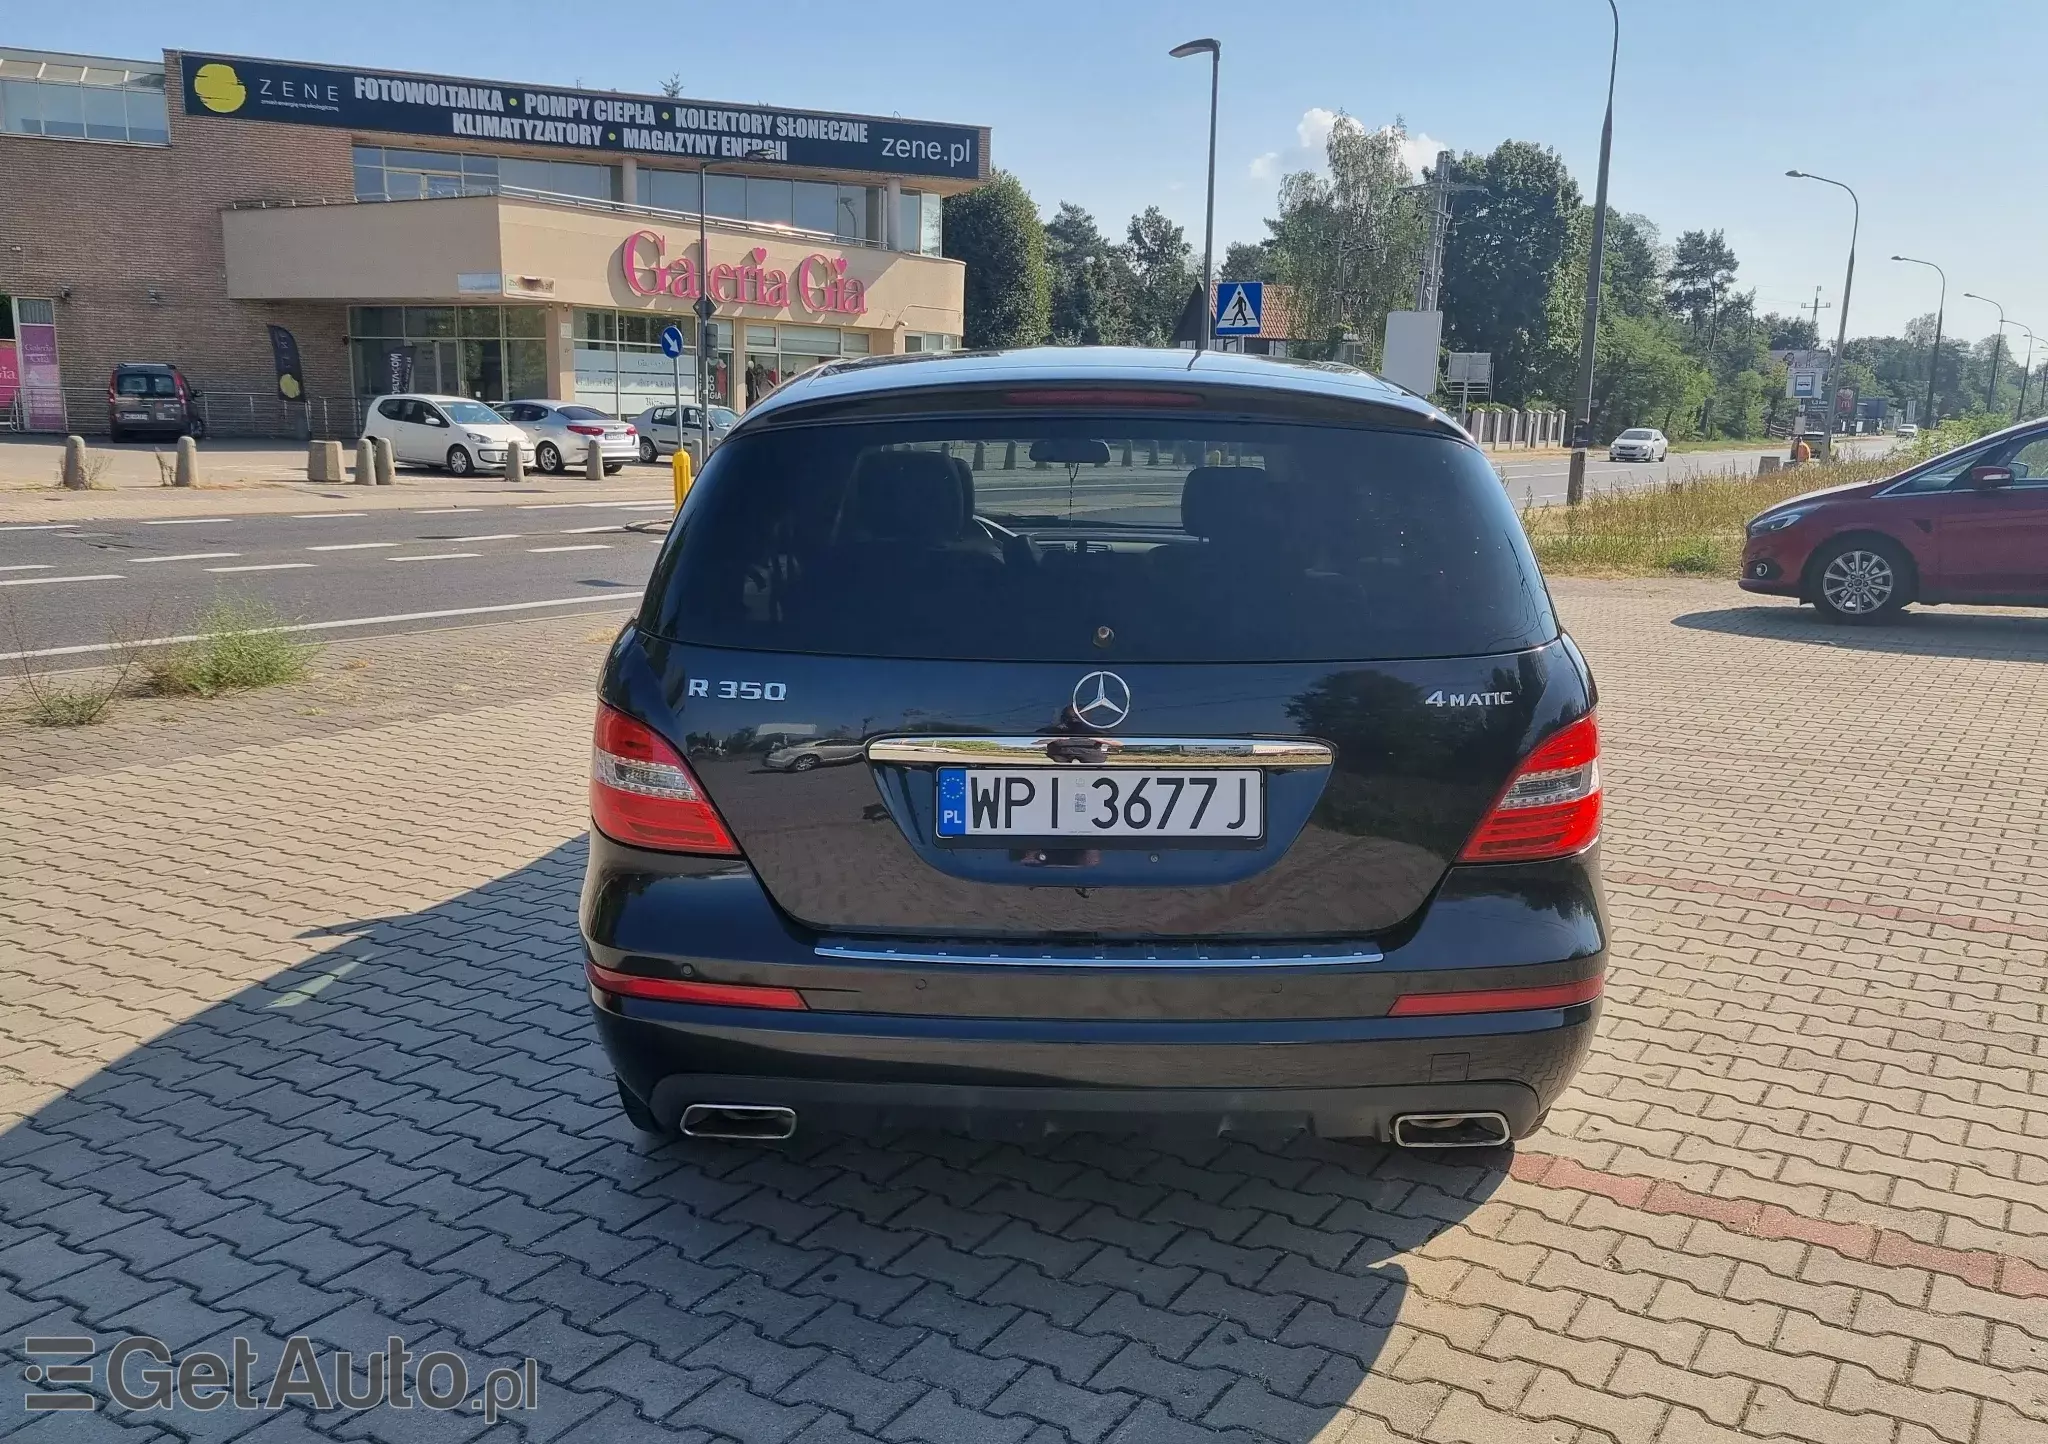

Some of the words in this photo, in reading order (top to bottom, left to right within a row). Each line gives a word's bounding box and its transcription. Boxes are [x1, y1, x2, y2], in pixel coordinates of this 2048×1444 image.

[259, 78, 339, 102] ZENE
[354, 76, 505, 113] FOTOWOLTAIKA
[524, 93, 590, 119] POMPY
[594, 100, 656, 126] CIEPŁA
[675, 106, 773, 136] KOLEKTORY
[776, 115, 869, 144] SŁONECZNE
[452, 112, 603, 146] KLIMATYZATORY
[622, 128, 719, 157] MAGAZYNY
[881, 136, 971, 168] zene.pl
[622, 230, 791, 308] Galeria
[798, 253, 868, 314] Gia
[688, 679, 709, 698] R
[717, 680, 787, 701] 350
[943, 810, 962, 824] PL
[970, 776, 1060, 830] WPI
[1090, 776, 1247, 830] 3677J
